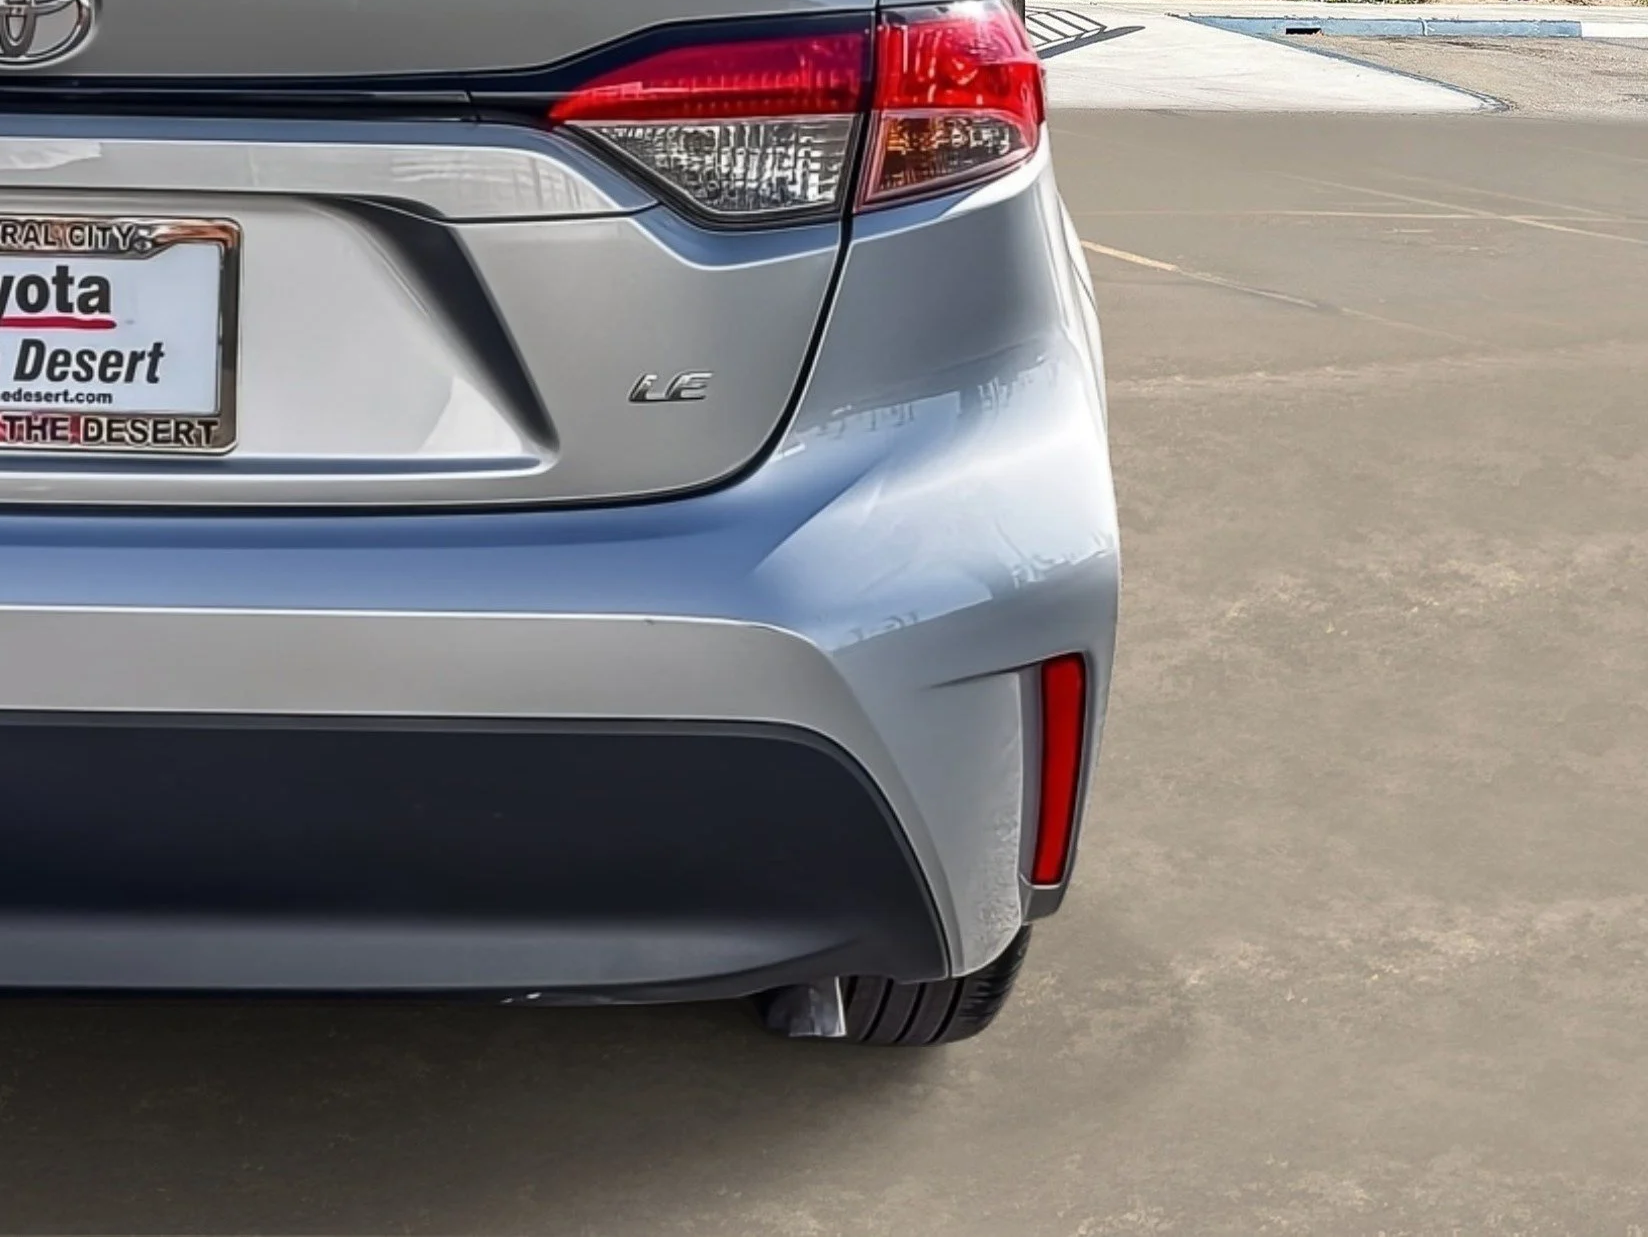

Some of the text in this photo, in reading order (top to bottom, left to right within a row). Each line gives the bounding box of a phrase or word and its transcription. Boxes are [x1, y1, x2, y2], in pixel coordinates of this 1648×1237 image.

[67, 222, 136, 250] CITY
[15, 340, 165, 384] Desert
[628, 369, 714, 403] LE
[1, 414, 70, 442] THE
[80, 416, 219, 446] DESERT
